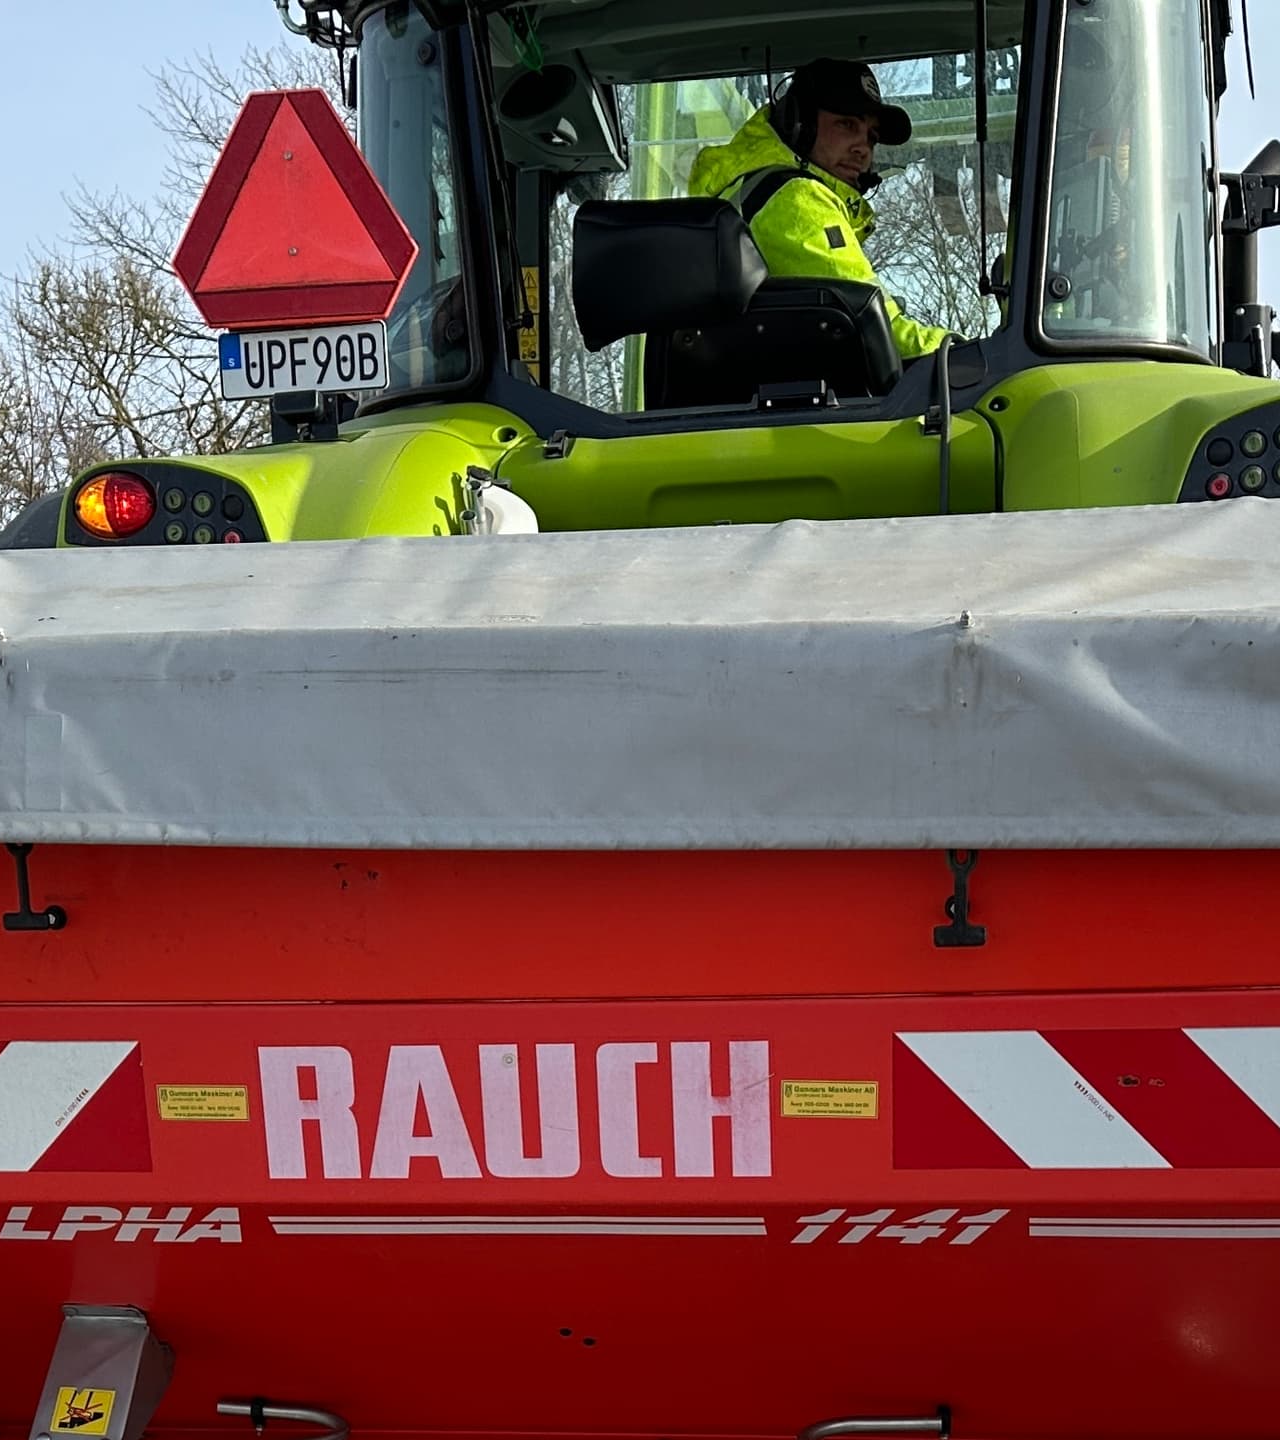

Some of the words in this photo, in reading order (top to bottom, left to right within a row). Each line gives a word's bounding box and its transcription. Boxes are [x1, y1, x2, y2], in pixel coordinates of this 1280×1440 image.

[244, 333, 378, 389] UPF90B
[258, 1041, 772, 1179] RAUCH
[790, 1208, 1011, 1244] 1141
